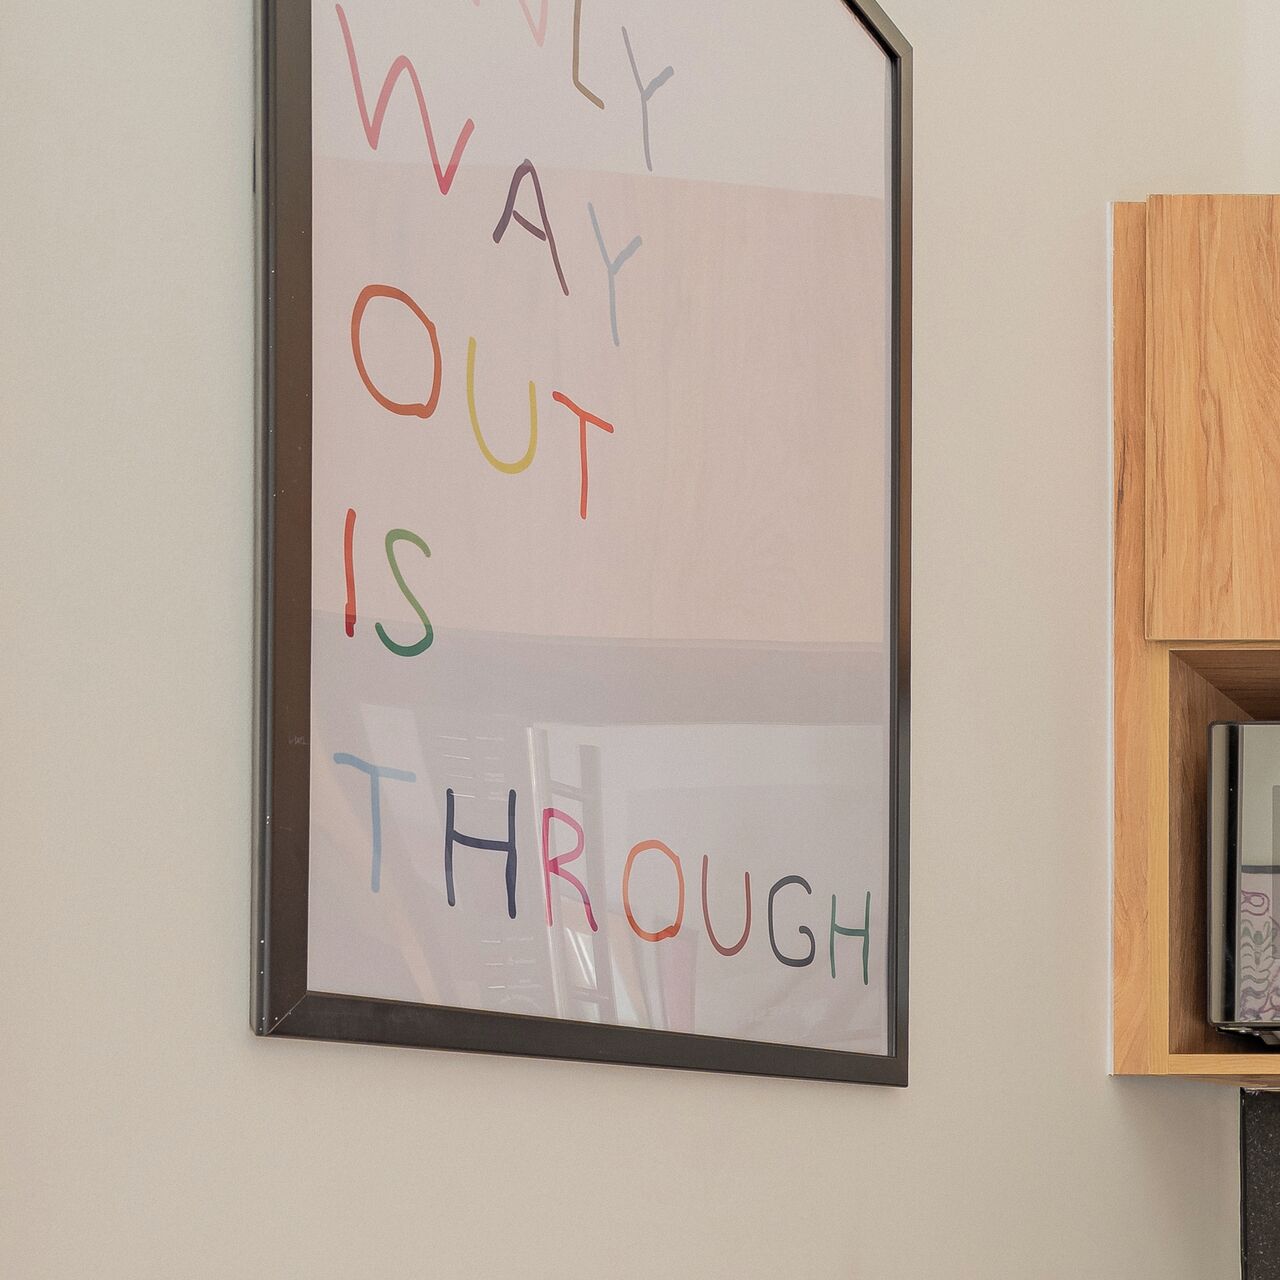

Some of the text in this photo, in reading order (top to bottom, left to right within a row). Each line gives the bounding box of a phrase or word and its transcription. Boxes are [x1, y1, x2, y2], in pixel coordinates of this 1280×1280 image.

[335, 3, 643, 347] WAY
[351, 284, 614, 519] OUT
[344, 508, 434, 657] IS
[333, 752, 871, 986] THROUGH
